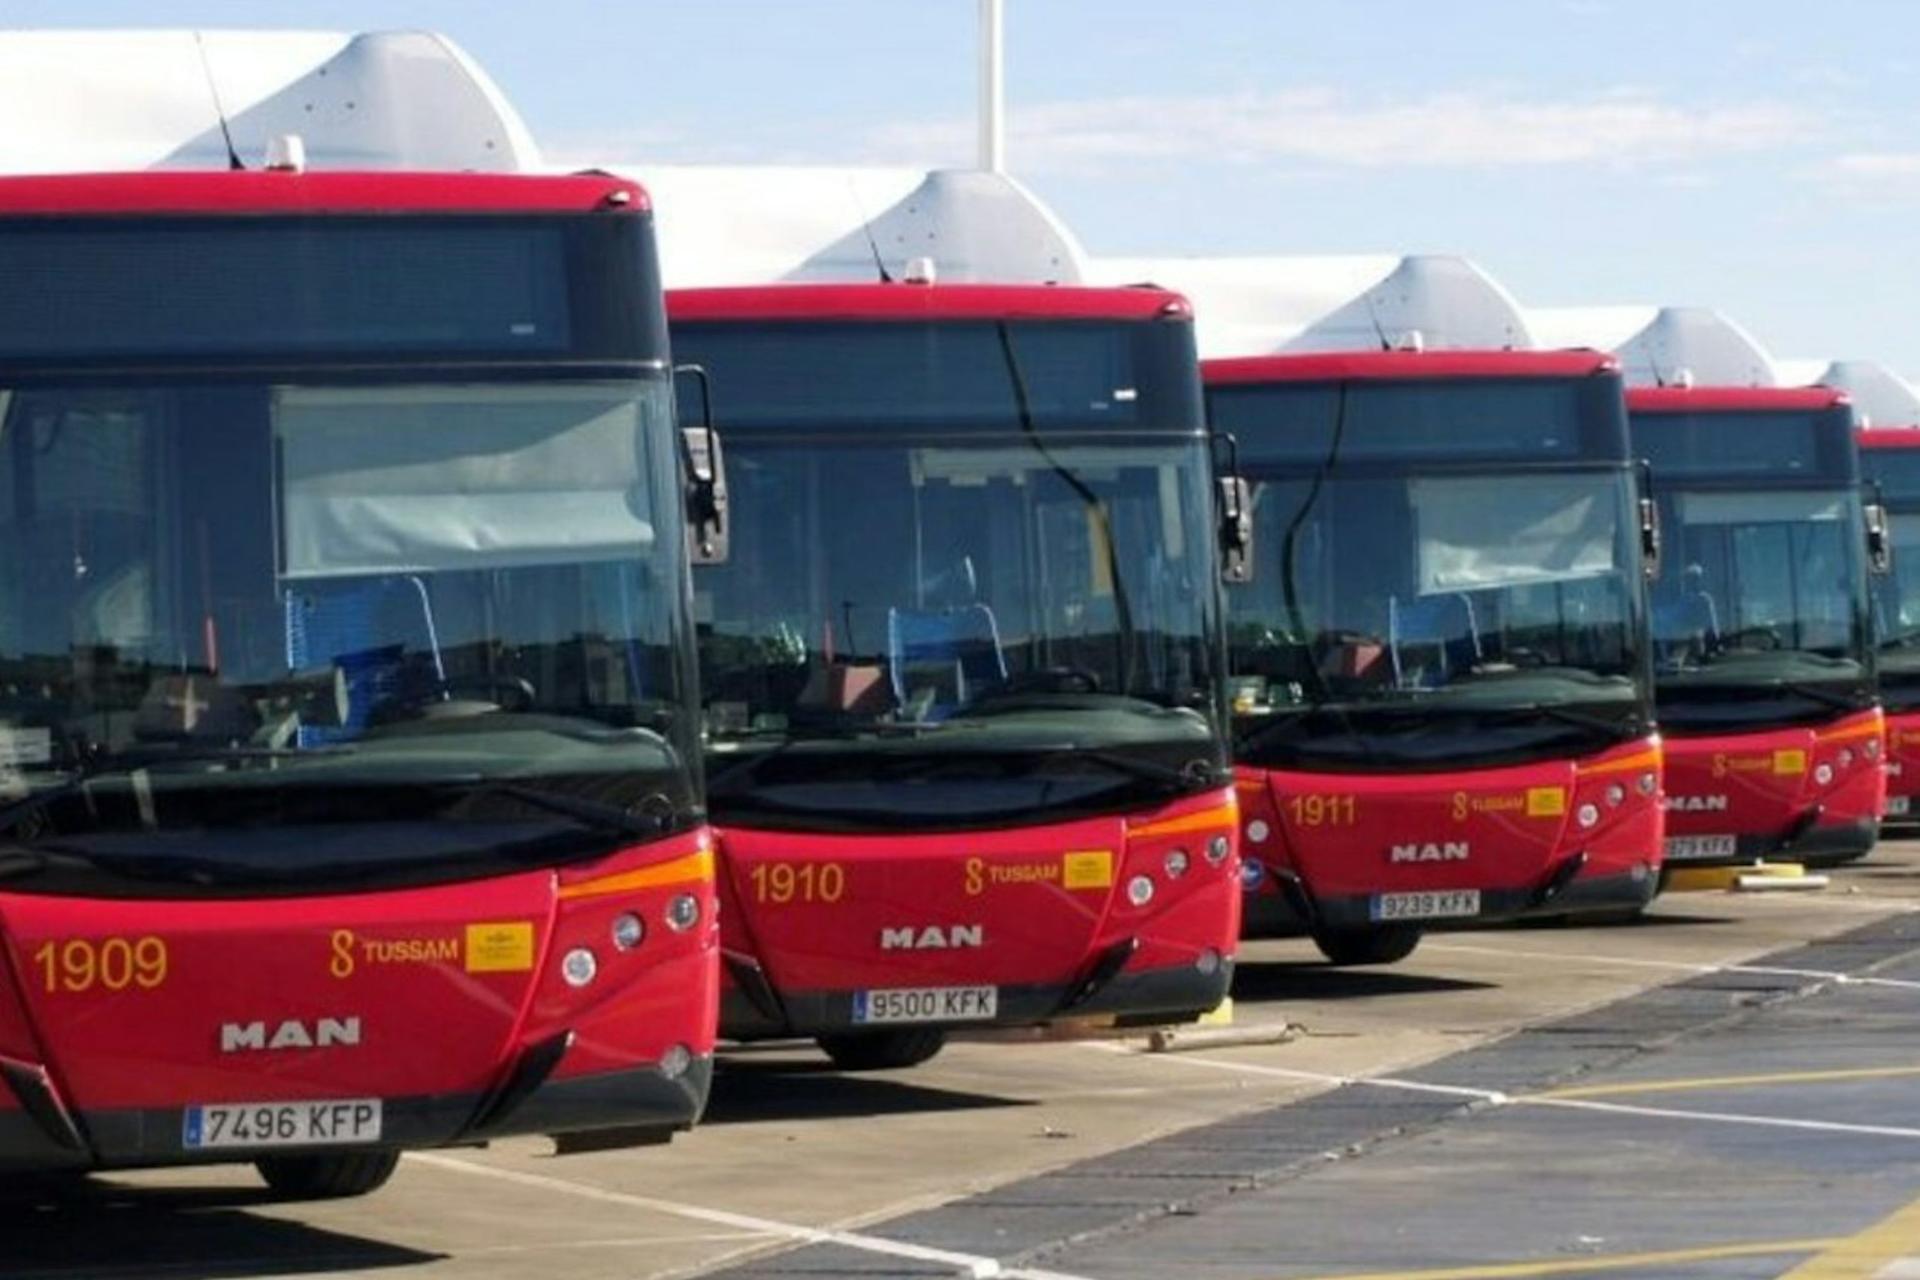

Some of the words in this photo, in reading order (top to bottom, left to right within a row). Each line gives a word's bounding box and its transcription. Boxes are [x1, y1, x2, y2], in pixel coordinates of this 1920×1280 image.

[1290, 796, 1356, 826] 1911
[1390, 842, 1469, 861] MAN
[751, 863, 844, 903] 1910
[989, 864, 1059, 884] TUSSAM
[1438, 892, 1478, 913] KFK
[362, 938, 459, 963] TUSSAM
[880, 925, 984, 949] MAN
[34, 936, 168, 993] 1909
[871, 988, 937, 1020] 9500
[943, 986, 993, 1015] KFK
[220, 1016, 361, 1052] MAN
[208, 1107, 297, 1144] 7496
[308, 1103, 375, 1137] KFP
